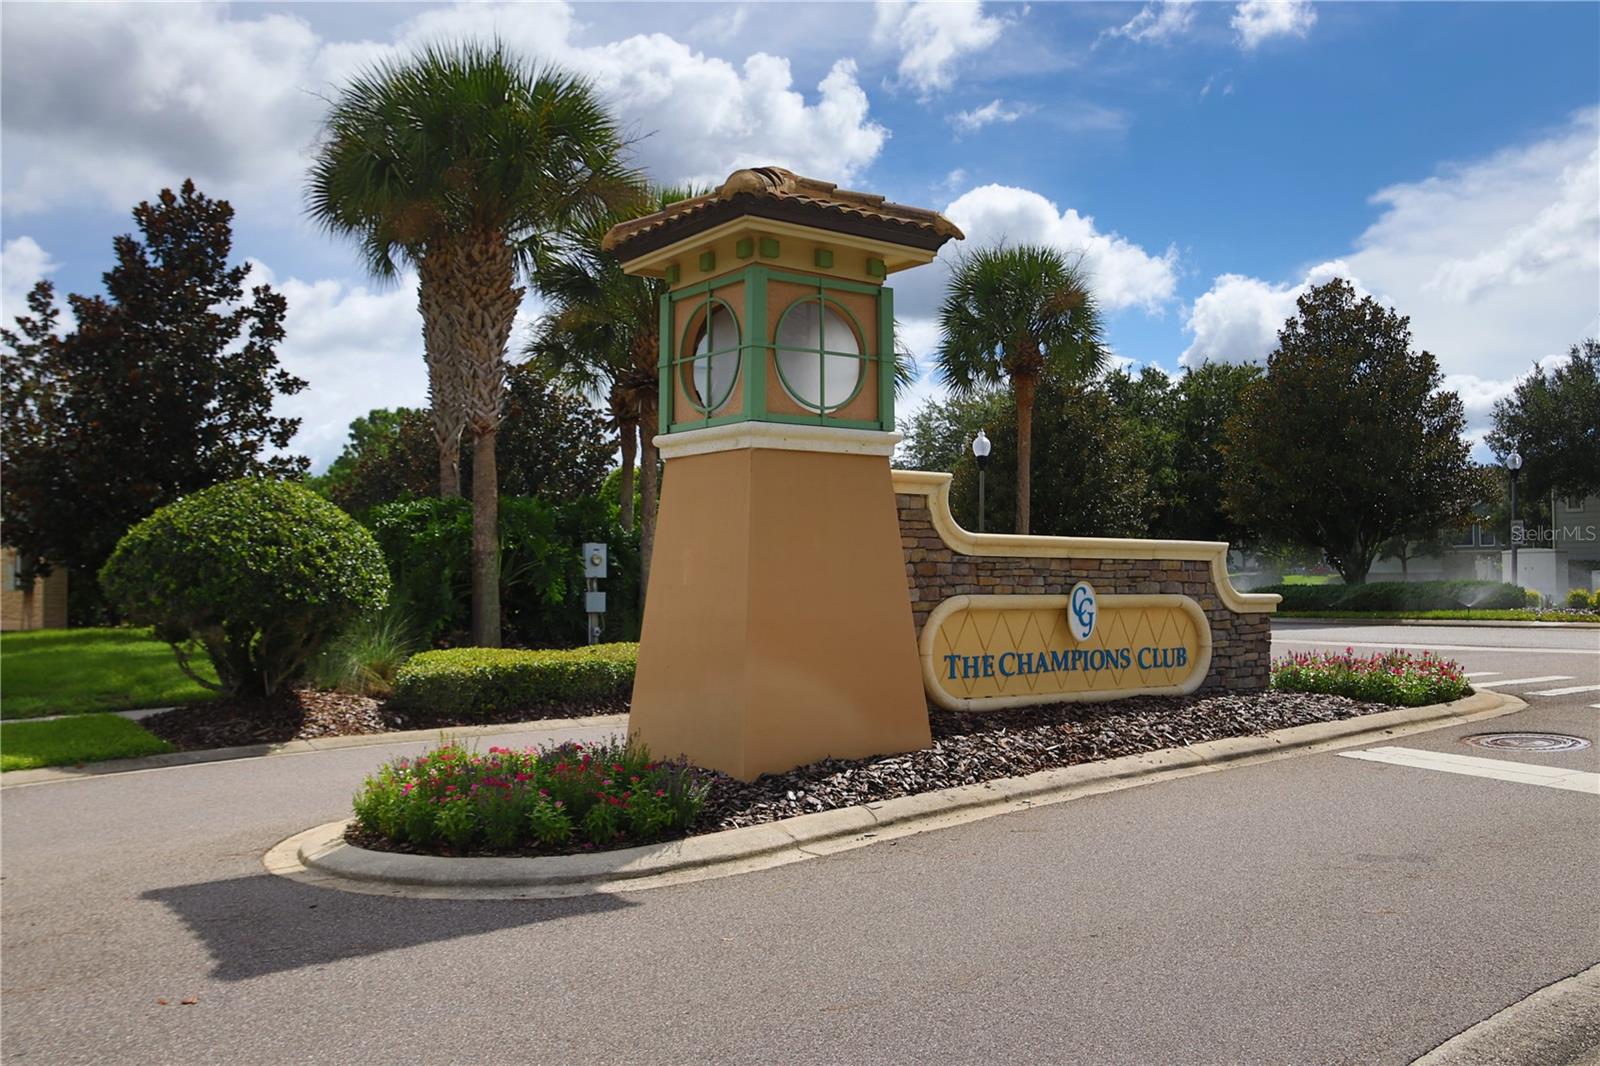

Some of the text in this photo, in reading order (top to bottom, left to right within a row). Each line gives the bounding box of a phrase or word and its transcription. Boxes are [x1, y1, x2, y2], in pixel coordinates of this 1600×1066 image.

[944, 647, 1187, 680] THE CHAMPIONS CLUB
